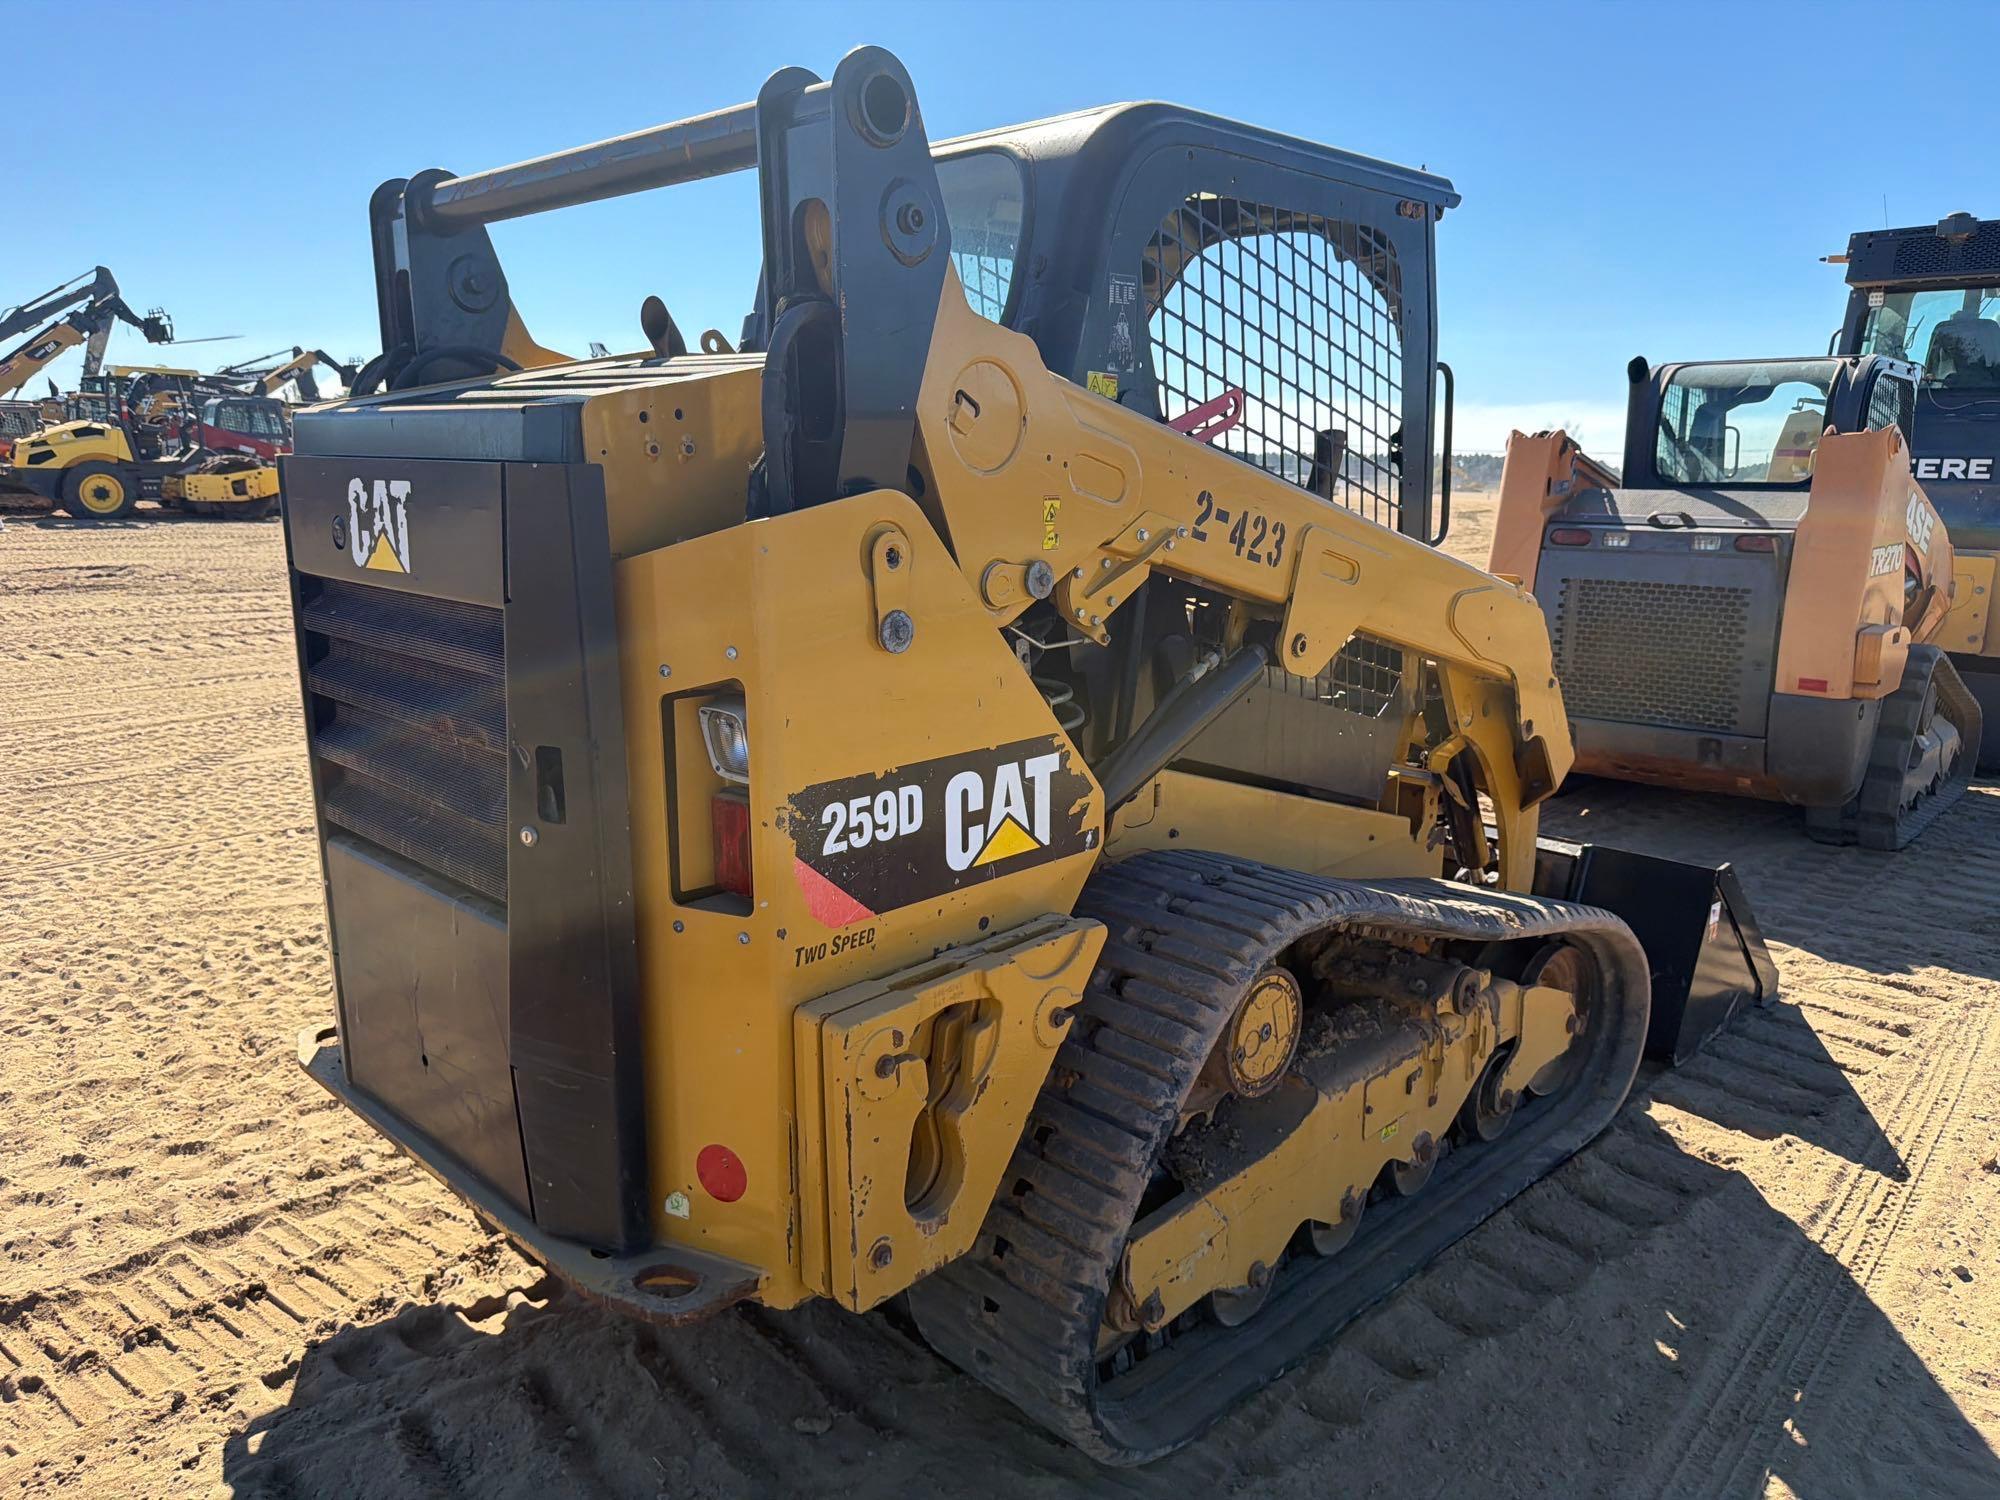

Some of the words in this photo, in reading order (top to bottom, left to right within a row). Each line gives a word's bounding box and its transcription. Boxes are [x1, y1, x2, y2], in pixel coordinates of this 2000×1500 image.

[1911, 458, 1993, 480] ERE
[347, 477, 412, 574] CAT
[1191, 489, 1286, 568] 2-423
[1905, 491, 1935, 555] ASE
[1870, 543, 1904, 577] TR270
[821, 784, 924, 857] 259D
[944, 751, 1061, 872] CAT
